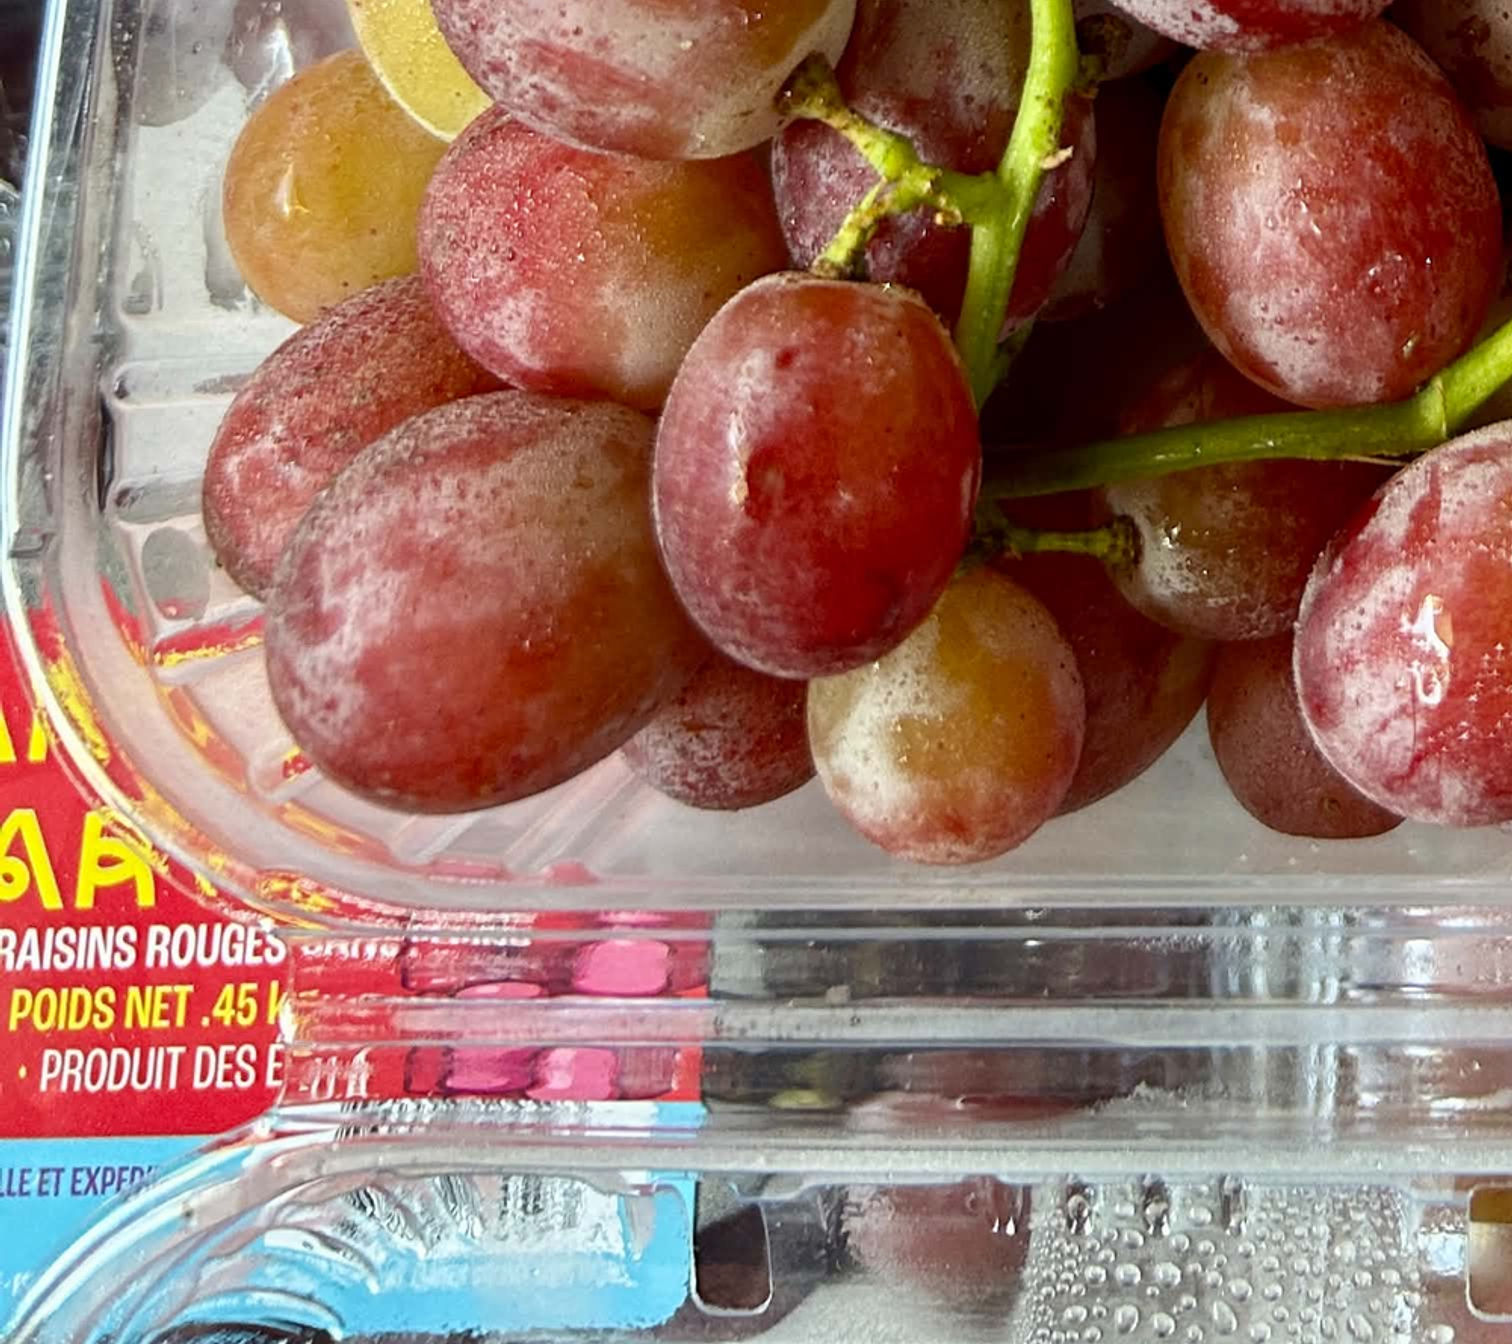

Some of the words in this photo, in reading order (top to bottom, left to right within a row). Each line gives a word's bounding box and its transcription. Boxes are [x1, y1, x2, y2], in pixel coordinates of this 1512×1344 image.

[0, 925, 137, 972] RAISINS
[145, 922, 287, 969] ROUGES
[8, 986, 116, 1032] POIDS
[124, 984, 194, 1029] NET
[201, 982, 259, 1027] .45
[40, 1045, 187, 1093] PRODUIT
[192, 1043, 257, 1089] DES
[37, 1167, 65, 1197] ET
